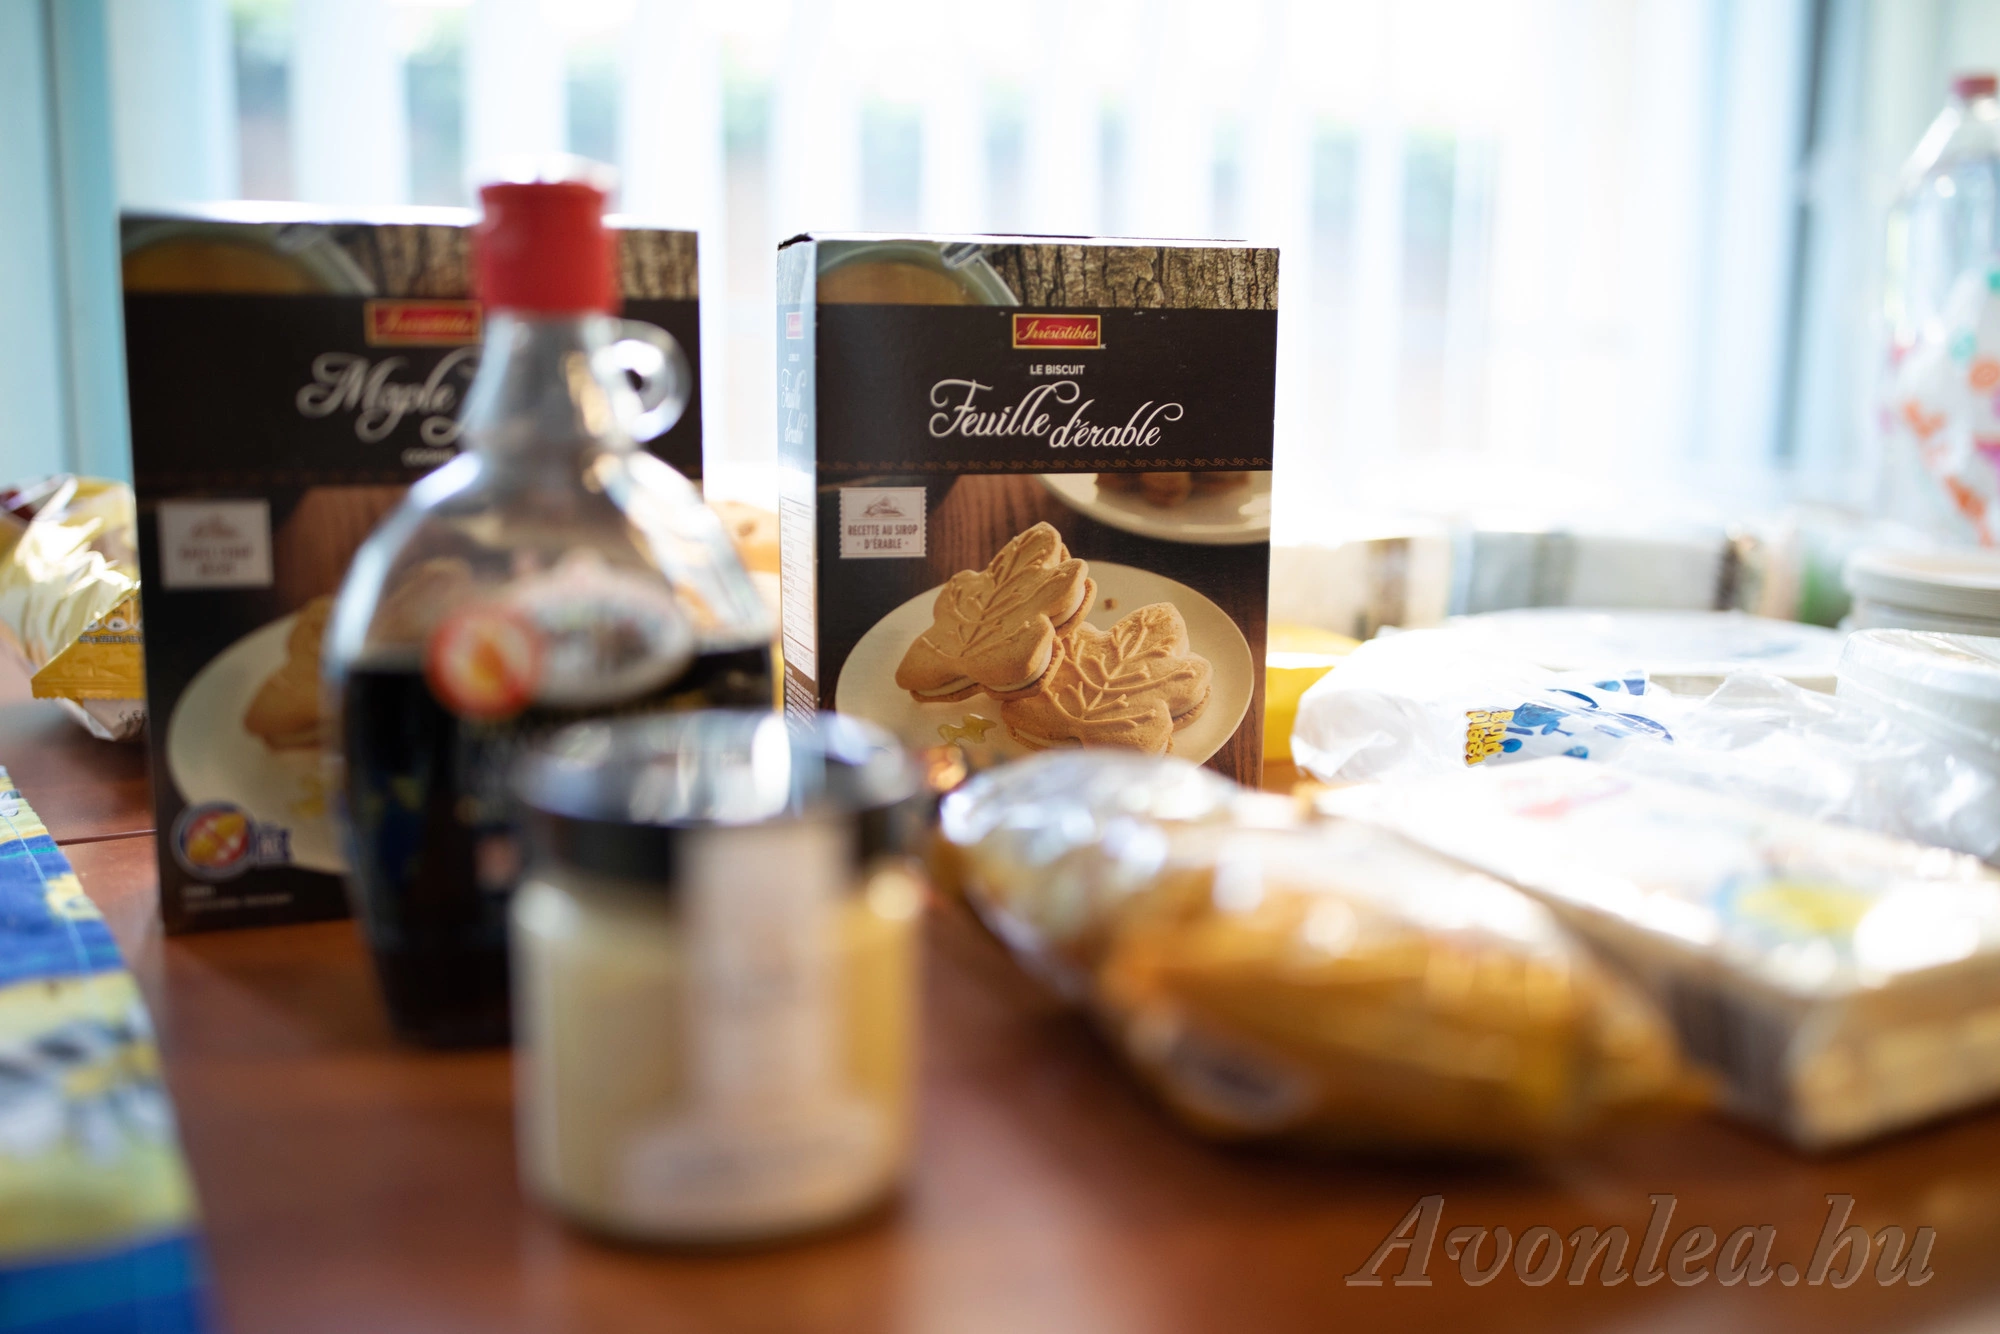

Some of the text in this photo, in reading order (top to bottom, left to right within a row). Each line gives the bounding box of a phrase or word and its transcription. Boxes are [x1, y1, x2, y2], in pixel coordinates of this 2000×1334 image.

[1016, 319, 1097, 341] Irresistibles
[1029, 364, 1086, 376] LE BISCUIT
[929, 378, 1184, 448] Feuille d'érable
[847, 524, 918, 536] RECETTE AU SIROP
